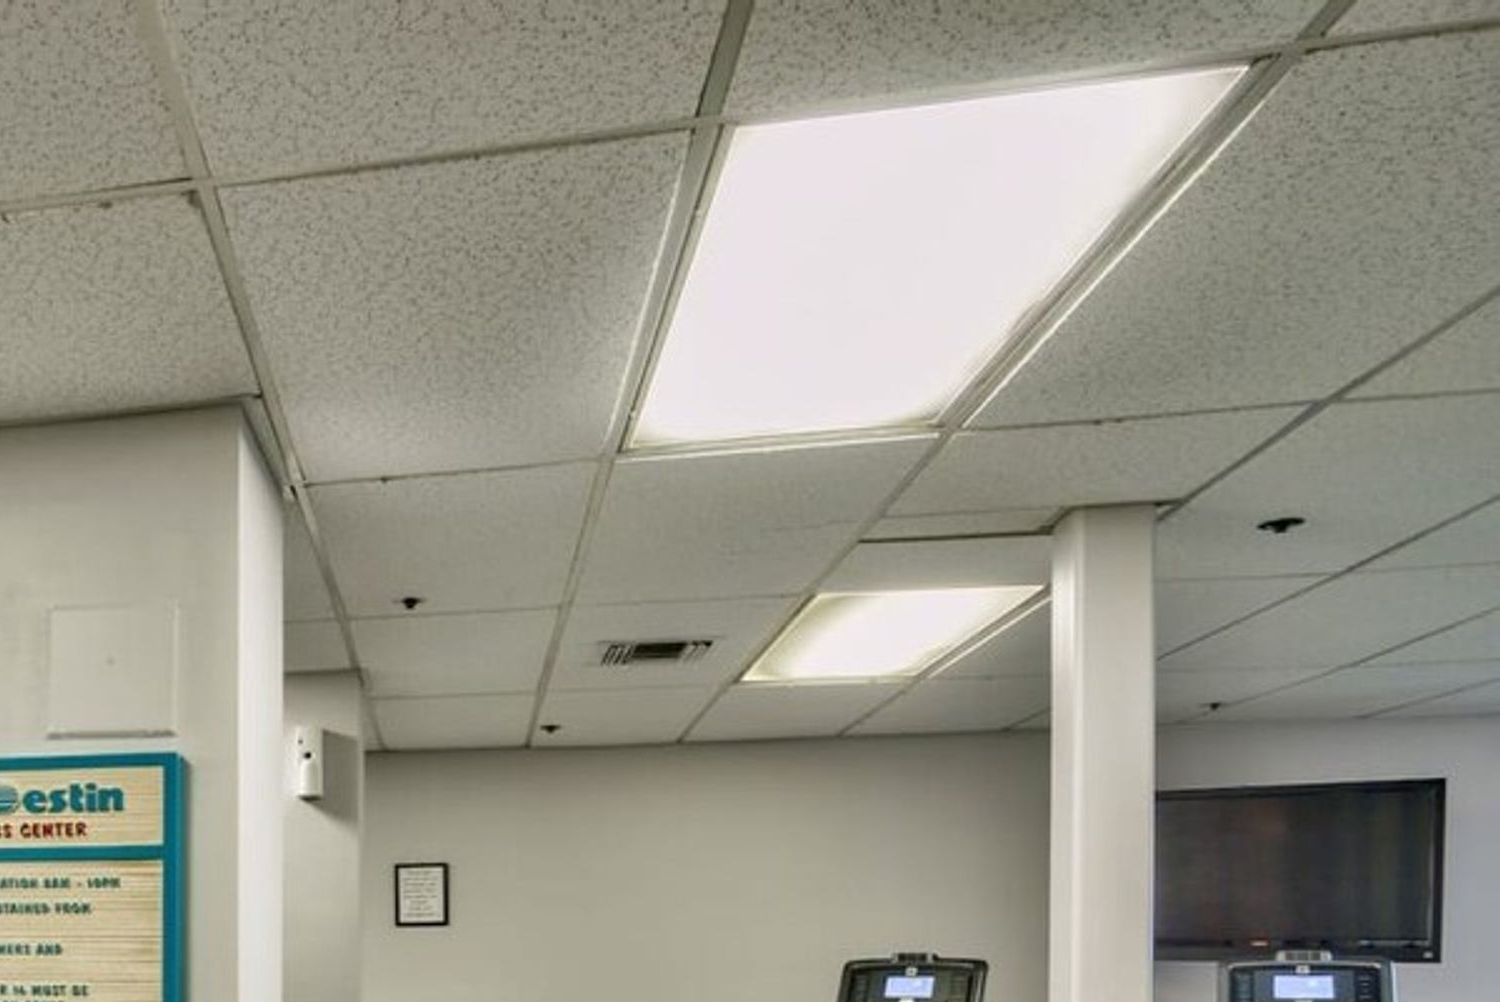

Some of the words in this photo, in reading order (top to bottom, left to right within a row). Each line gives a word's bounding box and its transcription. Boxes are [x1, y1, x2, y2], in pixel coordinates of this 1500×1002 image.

[20, 822, 88, 839] CENTER
[55, 902, 93, 914] FROM
[36, 944, 63, 955] AND
[32, 984, 67, 996] MUST
[72, 984, 90, 996] BE
